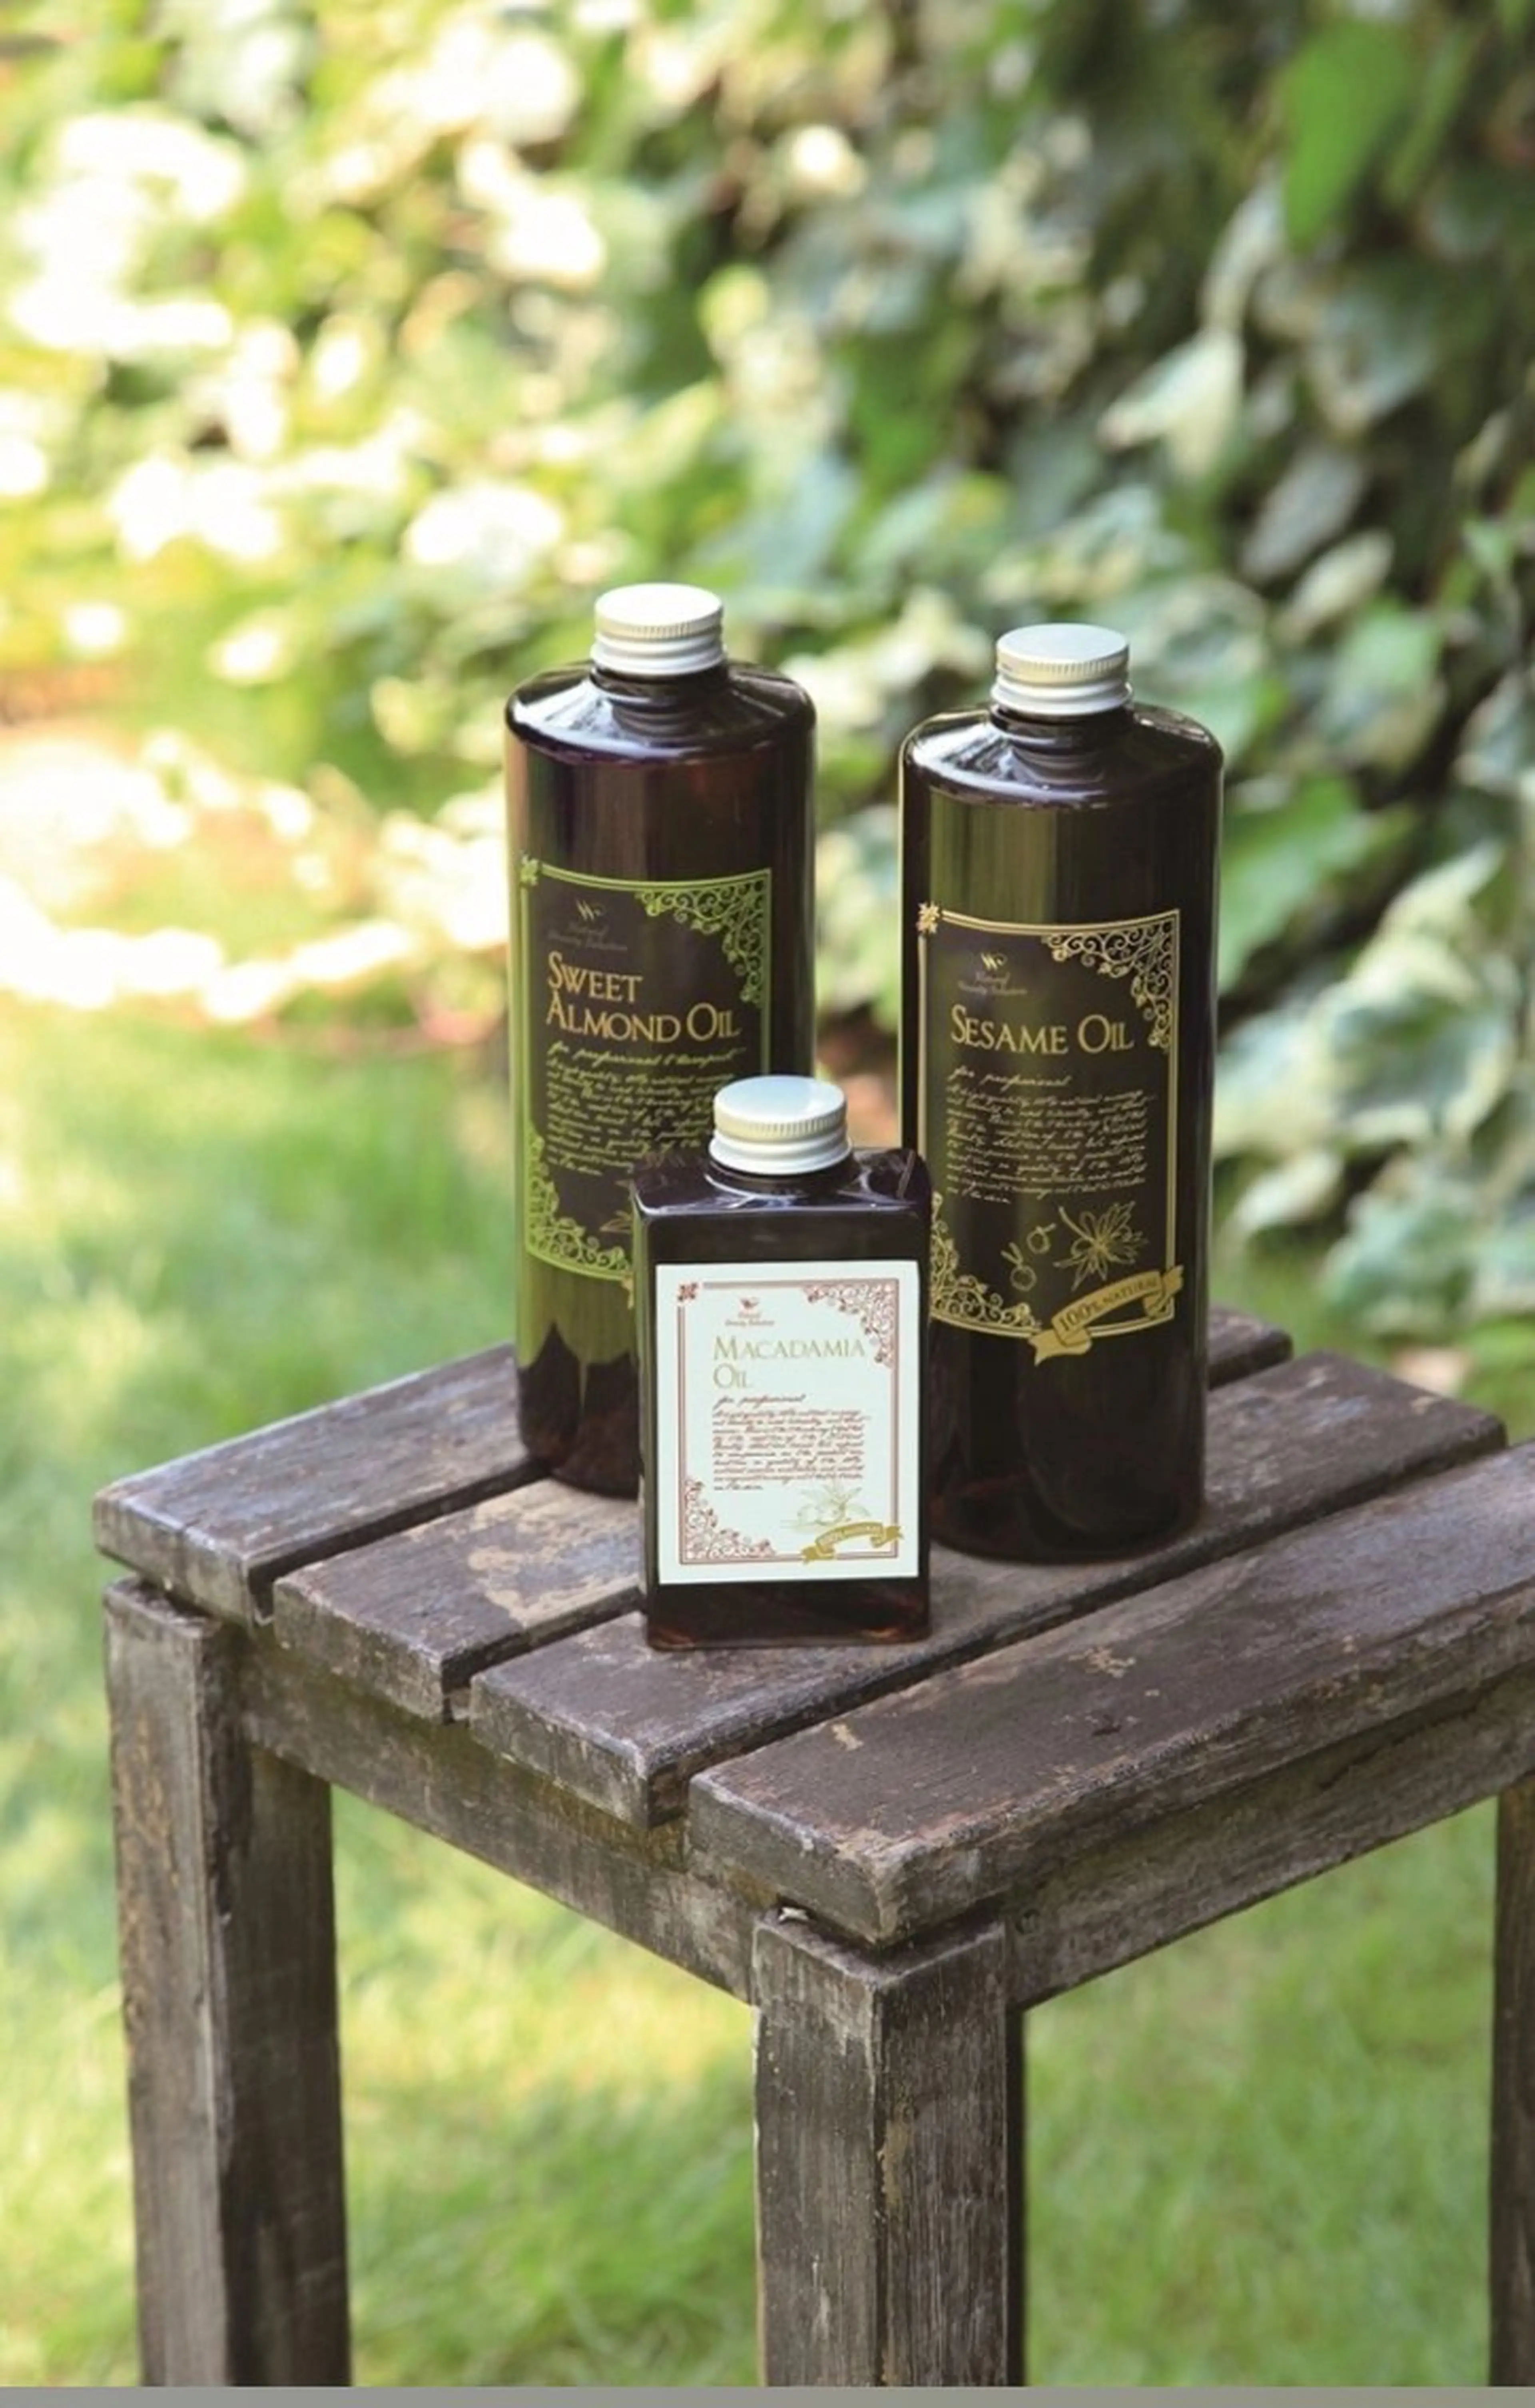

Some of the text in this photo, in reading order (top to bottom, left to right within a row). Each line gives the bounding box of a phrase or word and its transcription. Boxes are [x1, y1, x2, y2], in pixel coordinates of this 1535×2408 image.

[546, 950, 643, 1003] SWEET
[546, 989, 743, 1043] ALMOND OIL
[950, 1004, 1135, 1055] SESAME OIL
[714, 1335, 865, 1360] MACADAMIA
[713, 1362, 753, 1389] OIL
